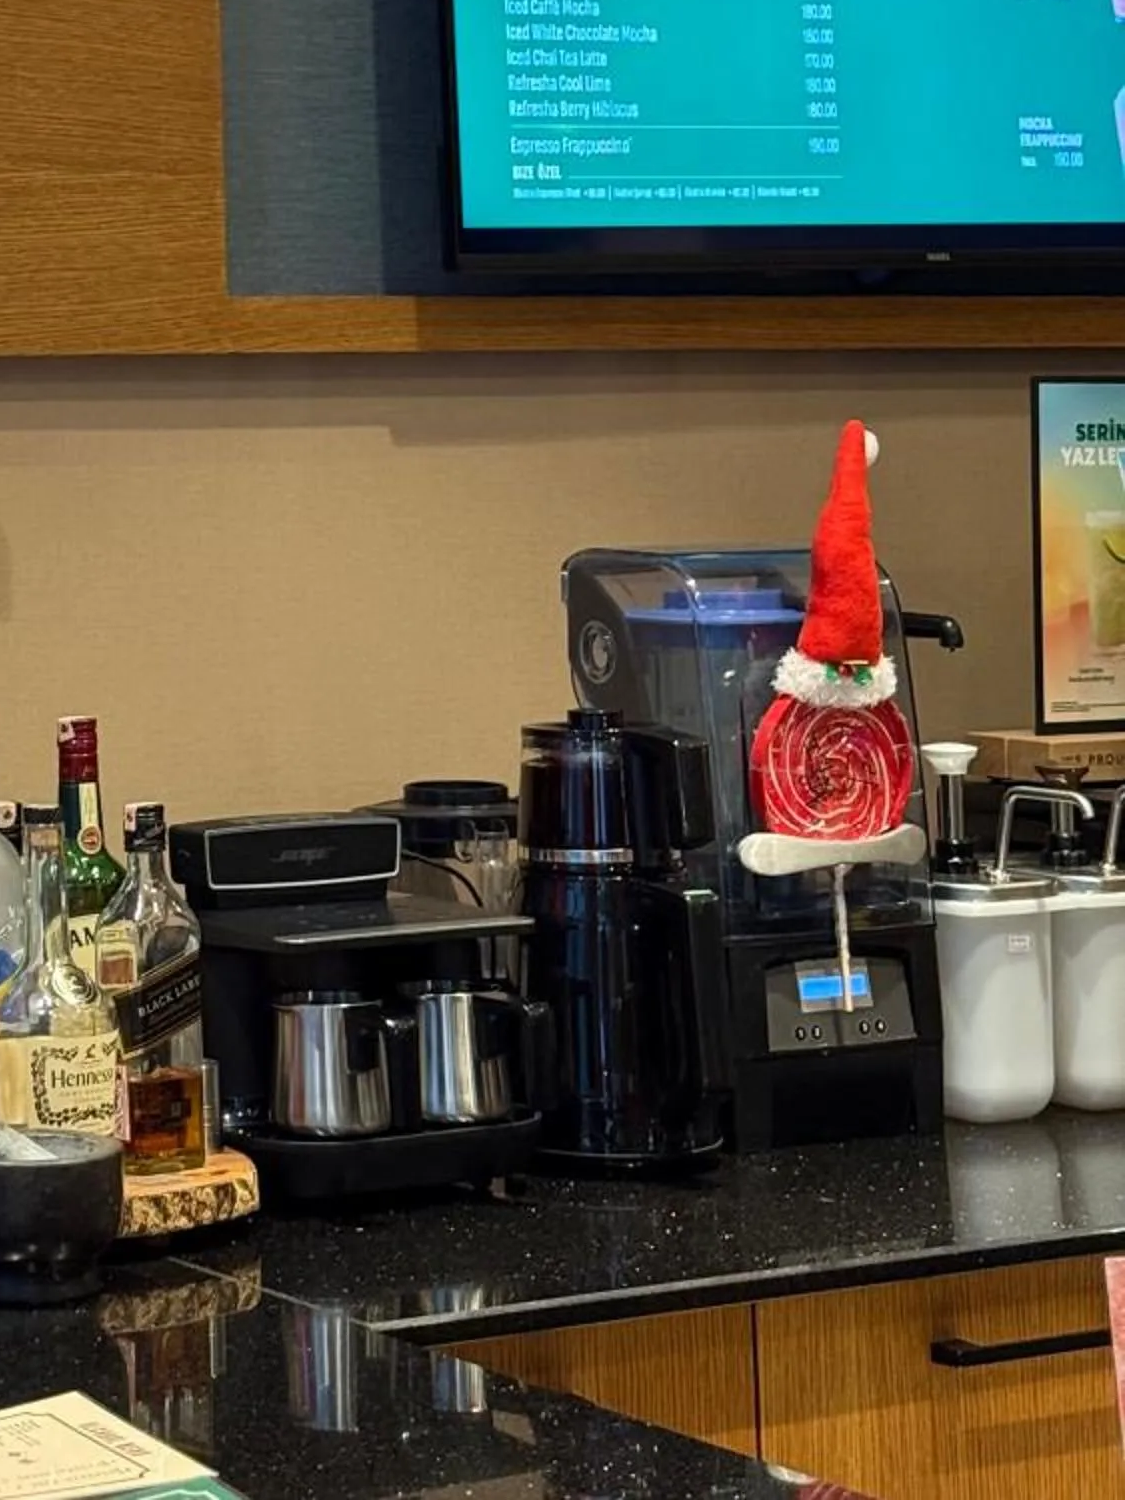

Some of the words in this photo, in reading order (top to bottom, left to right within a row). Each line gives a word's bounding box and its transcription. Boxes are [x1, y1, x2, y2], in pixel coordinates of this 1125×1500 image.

[506, 23, 530, 40] Iced
[531, 24, 563, 40] White
[565, 24, 619, 41] Chocolate
[622, 25, 657, 42] Mocha
[507, 48, 531, 66] Iced
[533, 48, 557, 66] Chai
[559, 49, 578, 66] Tea
[580, 50, 607, 66] Latte
[559, 74, 583, 92] Cool
[585, 75, 611, 92] Lime
[560, 100, 589, 120] Berry
[511, 136, 560, 156] Espresso
[1061, 446, 1095, 467] YAZ
[138, 992, 174, 1017] BLACK
